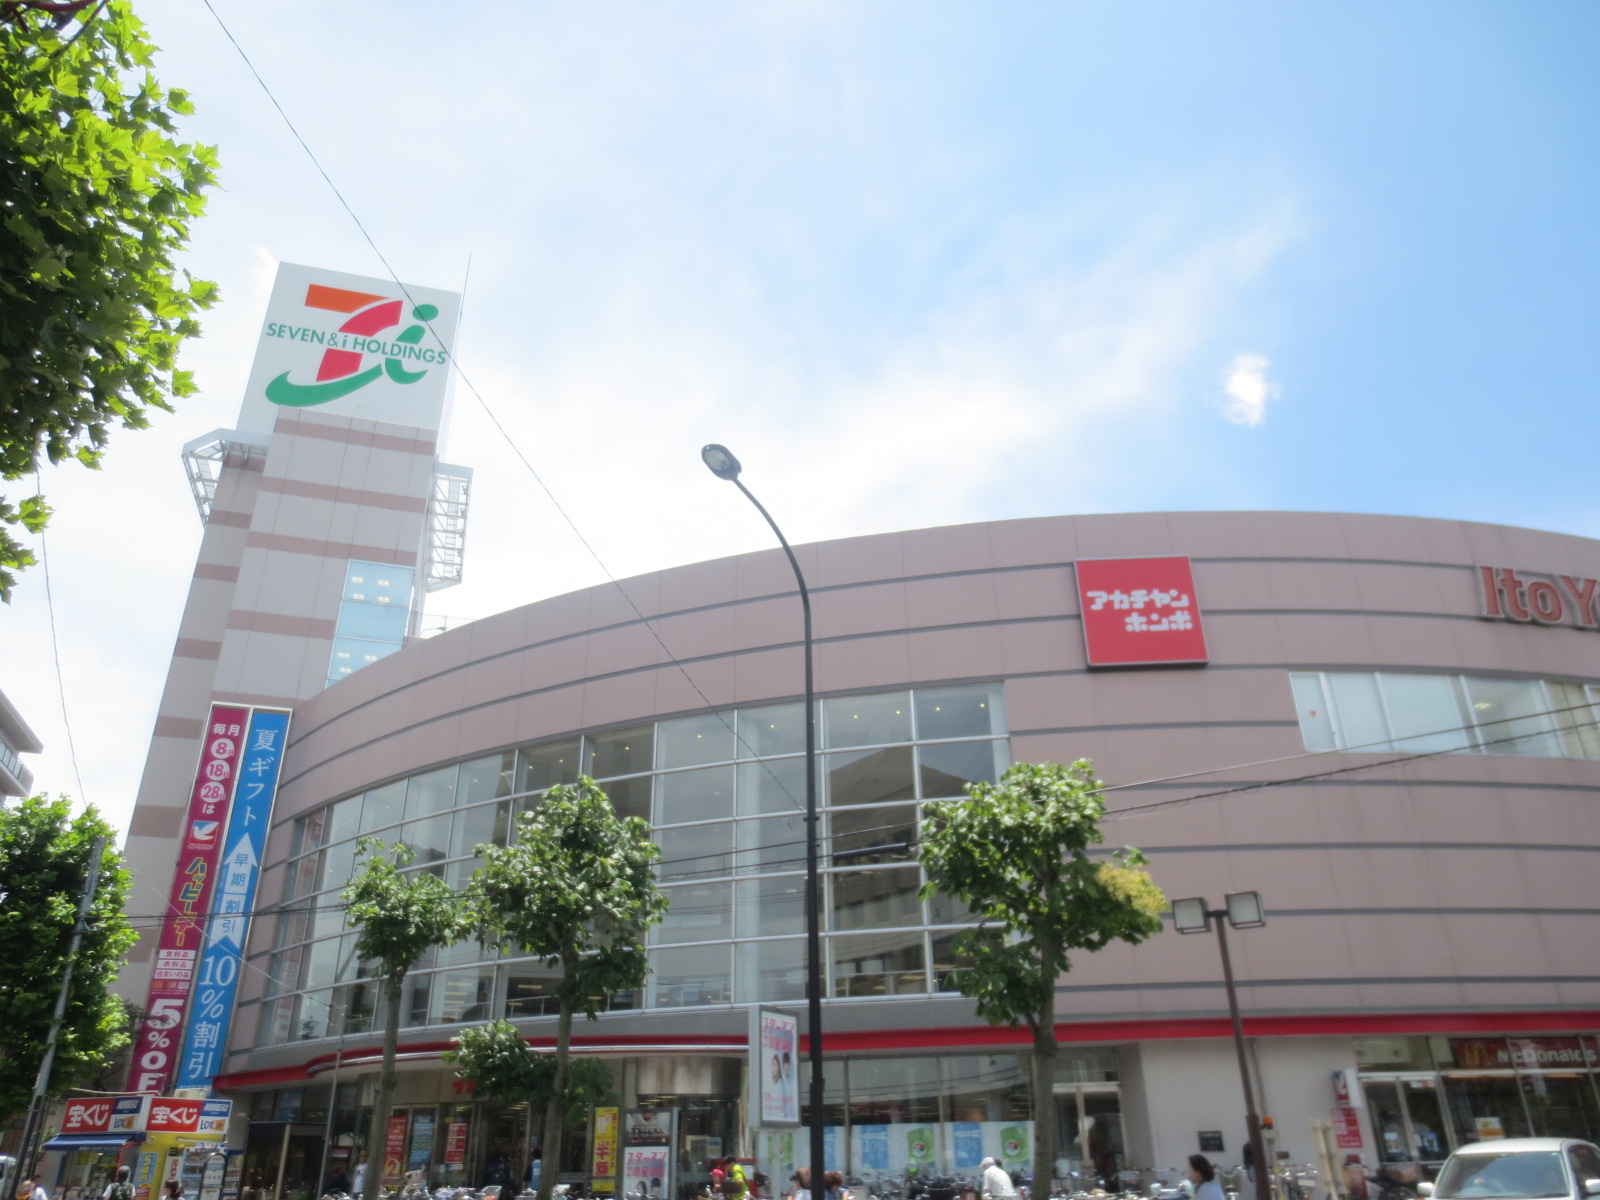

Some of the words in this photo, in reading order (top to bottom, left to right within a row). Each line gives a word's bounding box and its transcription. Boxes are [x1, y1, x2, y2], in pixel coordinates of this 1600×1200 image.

[353, 337, 446, 364] HOLDINGS
[1479, 565, 1600, 626] ItoY
[213, 723, 240, 736] 毎月
[245, 728, 278, 827] 夏ギフト
[66, 1104, 110, 1127] 宝くじ
[151, 1106, 198, 1125] 宝くじ
